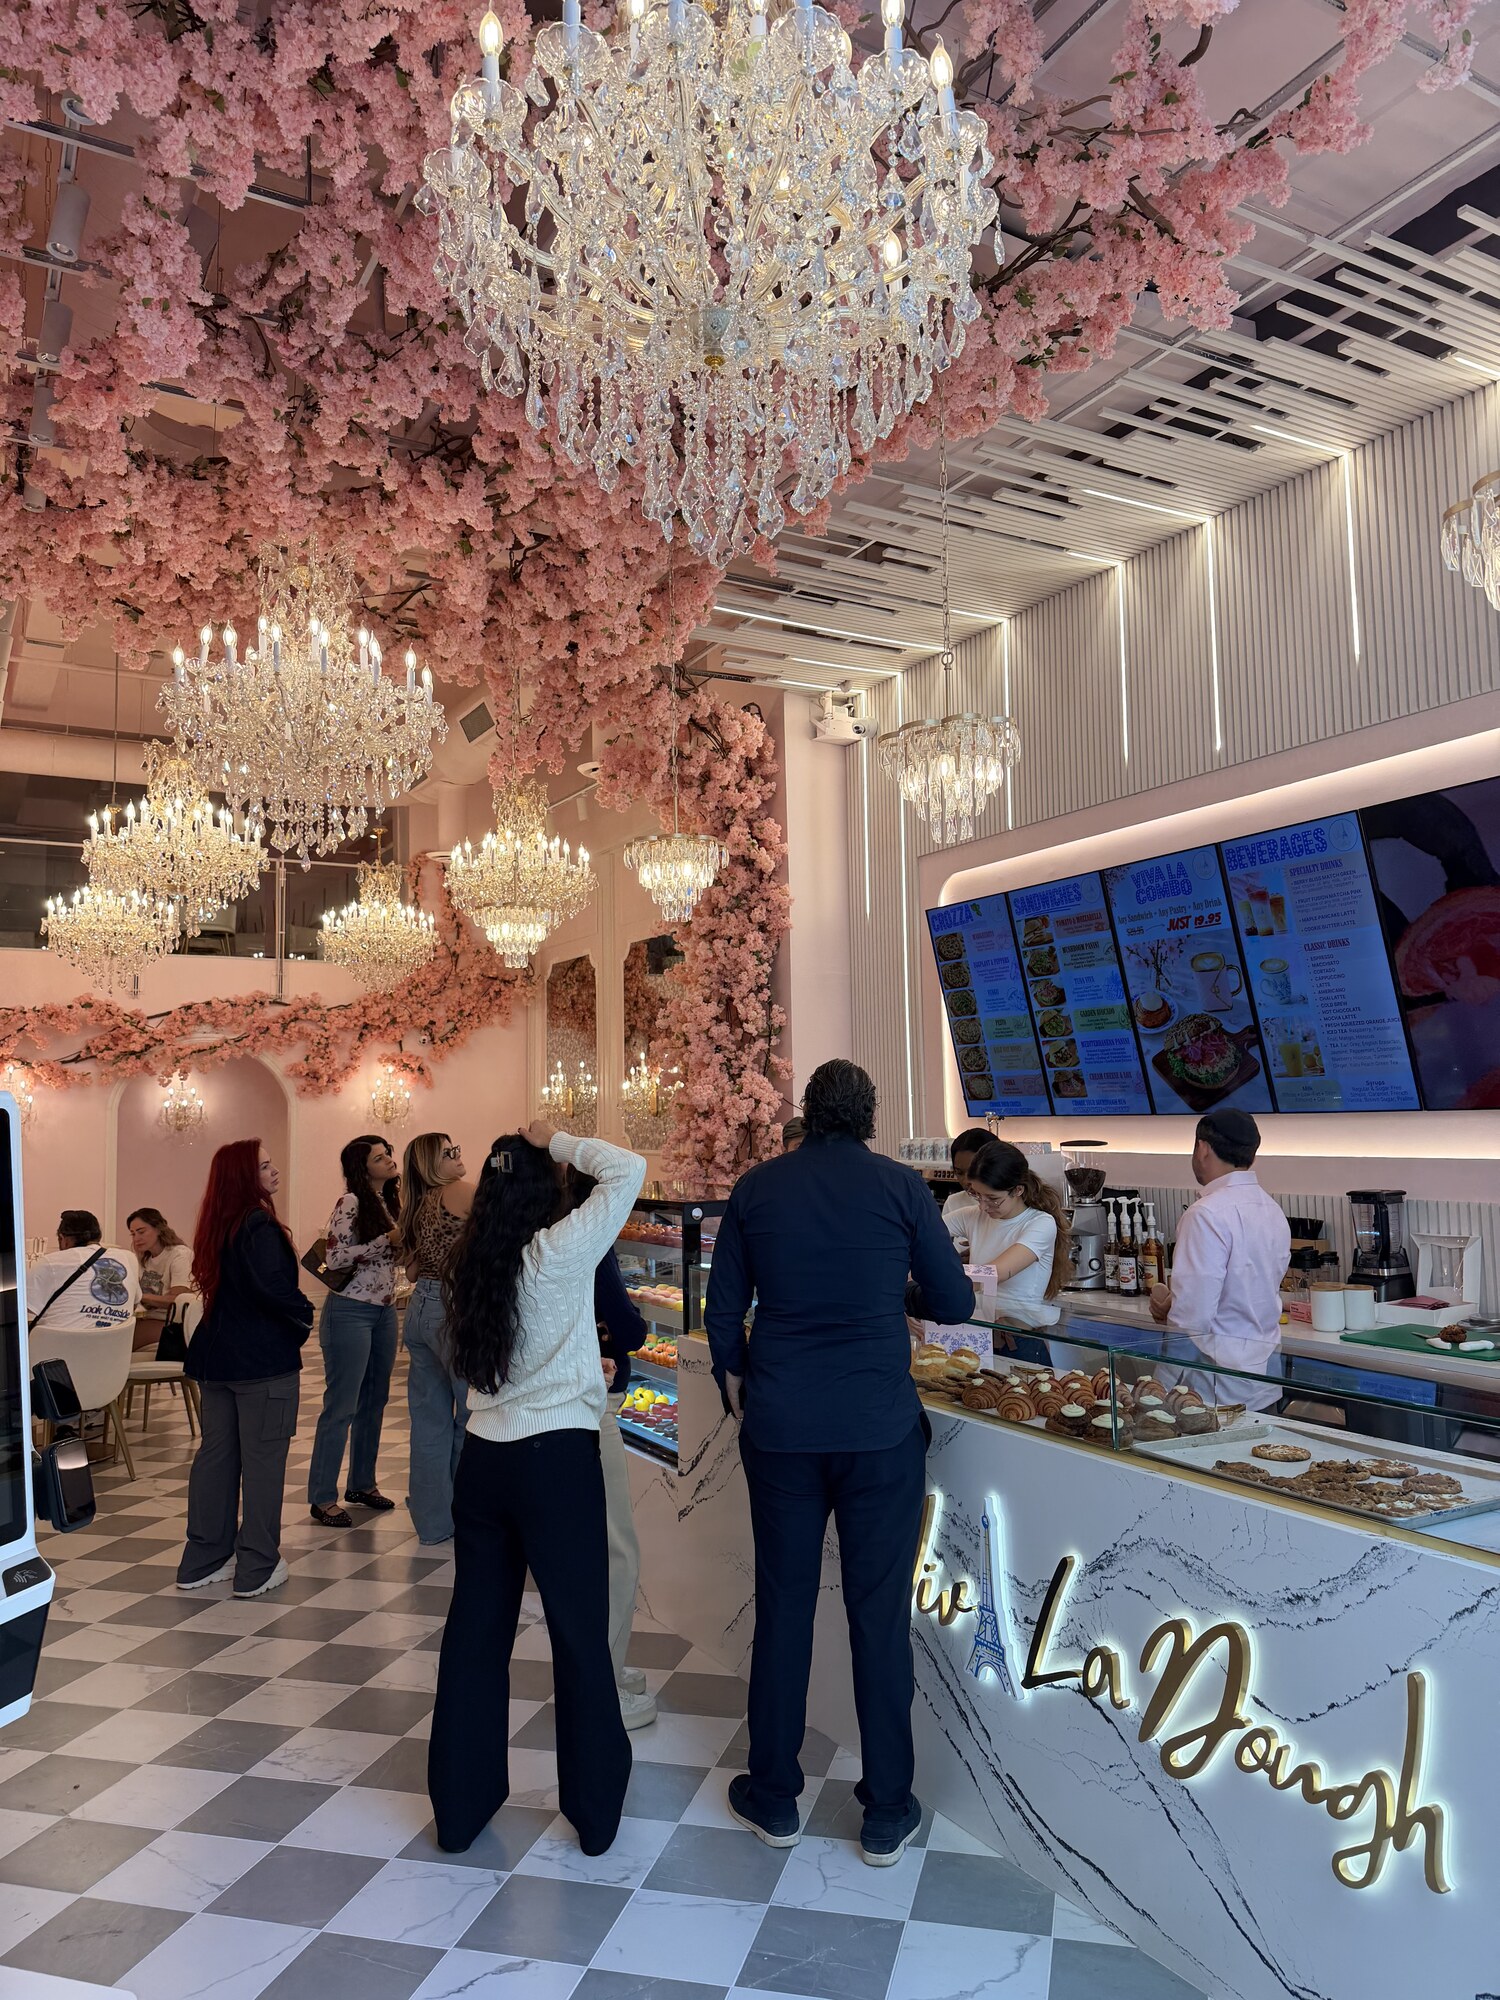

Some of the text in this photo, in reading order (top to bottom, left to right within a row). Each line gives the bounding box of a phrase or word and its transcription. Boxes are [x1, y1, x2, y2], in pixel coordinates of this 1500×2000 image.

[1225, 828, 1328, 871] BEVERAGES
[1131, 861, 1189, 889] VIVA LA
[1289, 858, 1343, 877] SPECIALTY DRINKS
[1340, 869, 1356, 877] GREEN
[1013, 882, 1082, 916] SANDWICHES
[1136, 878, 1192, 905] COMBO
[930, 903, 974, 932] CROZZA
[1127, 910, 1154, 922] Sandwich
[1158, 908, 1169, 917] Any
[1169, 905, 1186, 915] Pastry
[1192, 901, 1204, 912] Any
[1205, 897, 1222, 908] Drink
[1167, 912, 1221, 931] JUST 19.95
[1304, 938, 1351, 952] CLASSIC DRINKS
[80, 1304, 130, 1319] Look Outside
[1021, 1555, 1131, 1710] La
[1139, 1617, 1454, 1895] Dough
